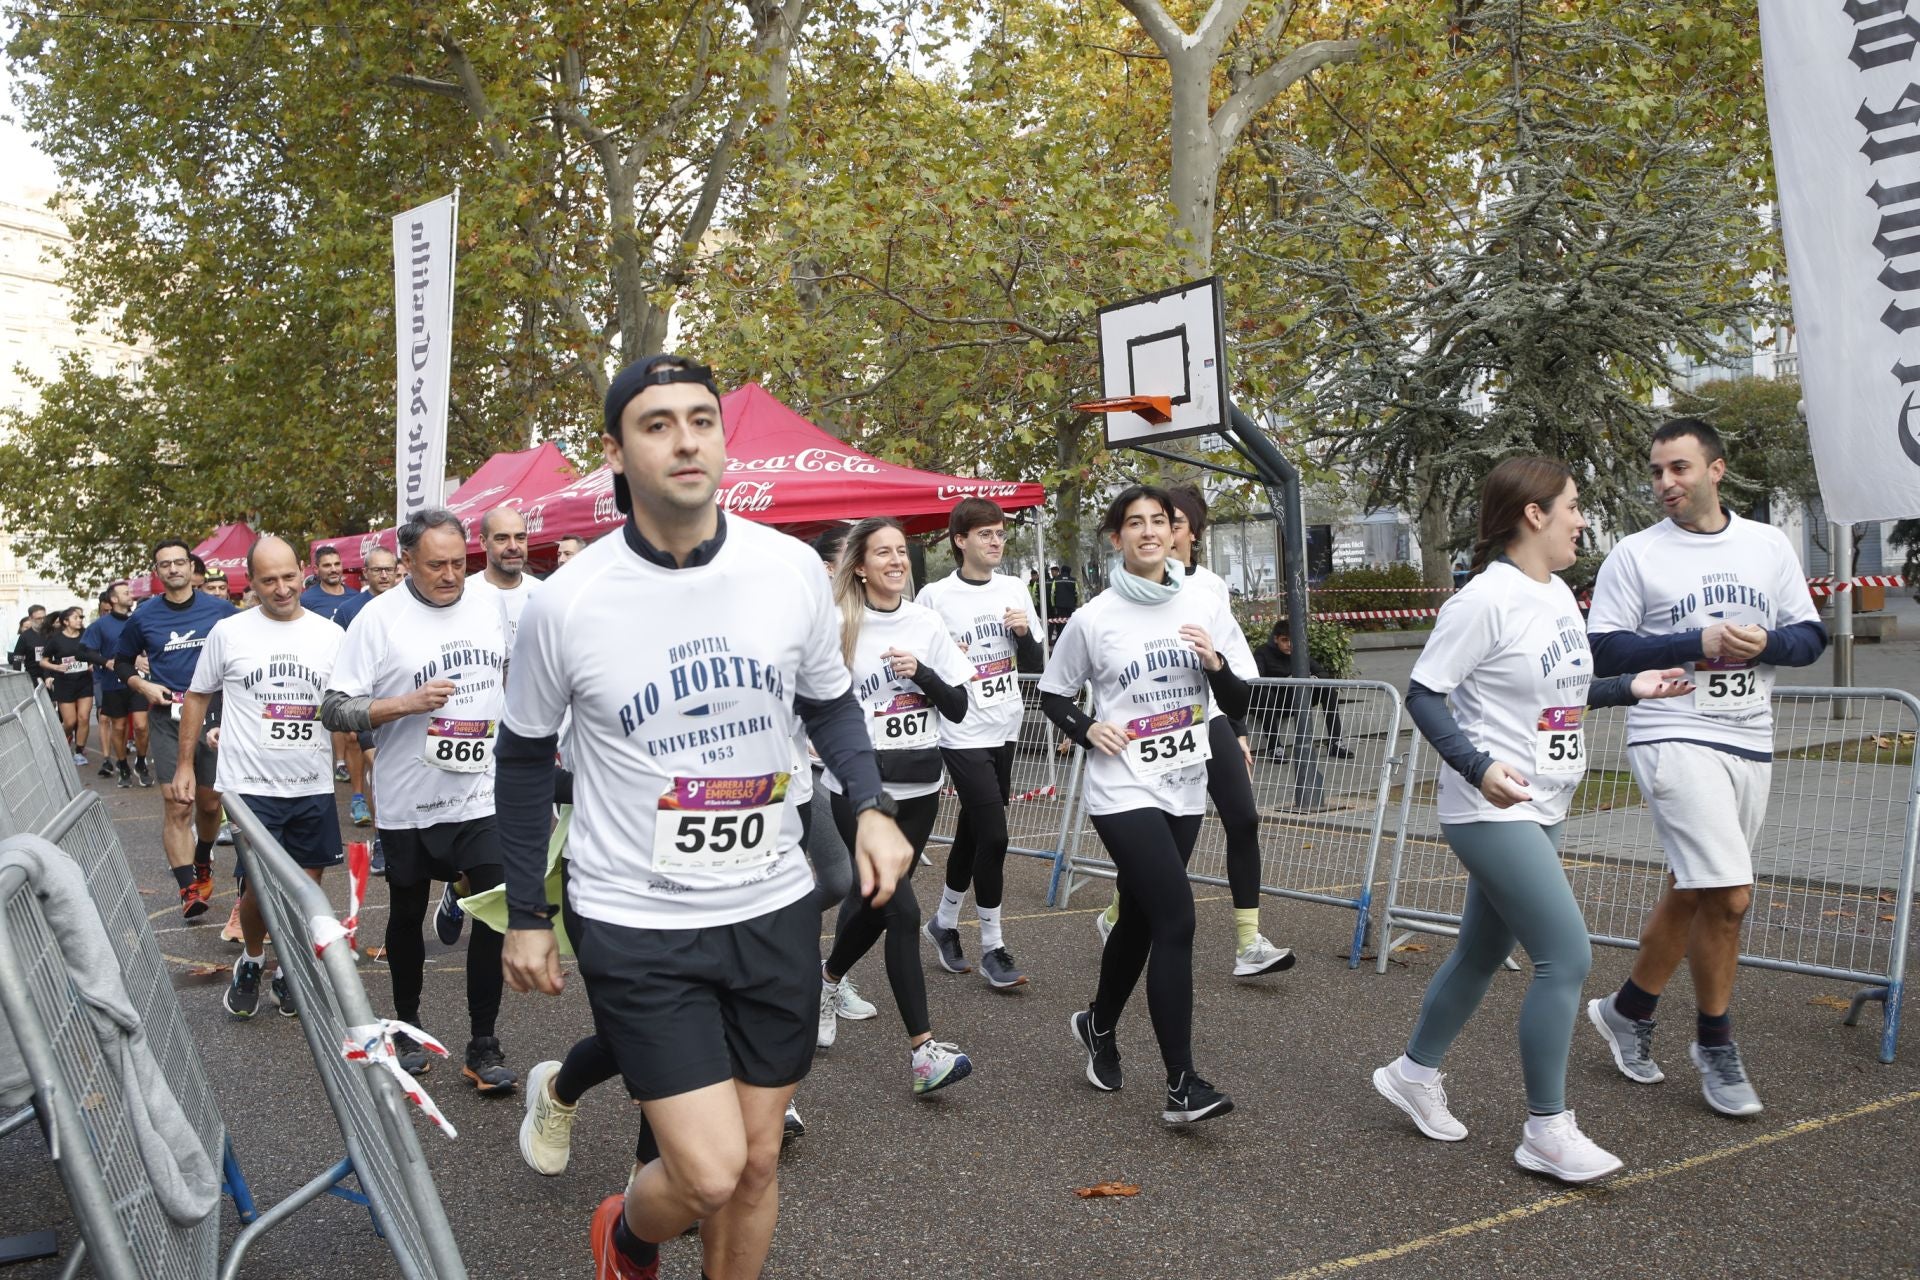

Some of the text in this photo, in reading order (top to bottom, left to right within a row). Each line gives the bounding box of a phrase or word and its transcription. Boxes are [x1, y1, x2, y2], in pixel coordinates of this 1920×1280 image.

[713, 481, 776, 513] a-Cola
[1702, 572, 1739, 585] HOSPITAL
[1670, 592, 1697, 626] RIO
[440, 639, 474, 652] HOSPITAL
[669, 636, 731, 664] HOSPITAL
[1144, 638, 1180, 652] HOSPITAL
[270, 653, 299, 663] HOSPITAL
[1118, 648, 1207, 691] RIO HORTE
[1540, 640, 1562, 678] RIO
[243, 662, 323, 692] RIO HORTEGA
[414, 660, 437, 690] RIO
[981, 674, 1013, 698] 541
[1708, 670, 1756, 698] 532
[254, 692, 314, 701] UNIVERSITARIO
[454, 678, 495, 696] RSITARIO
[618, 656, 785, 738] RIO HORTEGA
[456, 696, 474, 706] 1953
[1162, 701, 1181, 712] 1953
[270, 721, 314, 740] 535
[885, 710, 929, 738] 867
[435, 739, 486, 762] 866
[701, 746, 735, 765] 1953
[1140, 729, 1197, 763] 534
[686, 779, 755, 799] 9ª CARRERA DE
[705, 788, 754, 799] EMPRESAS
[674, 812, 765, 854] 550
